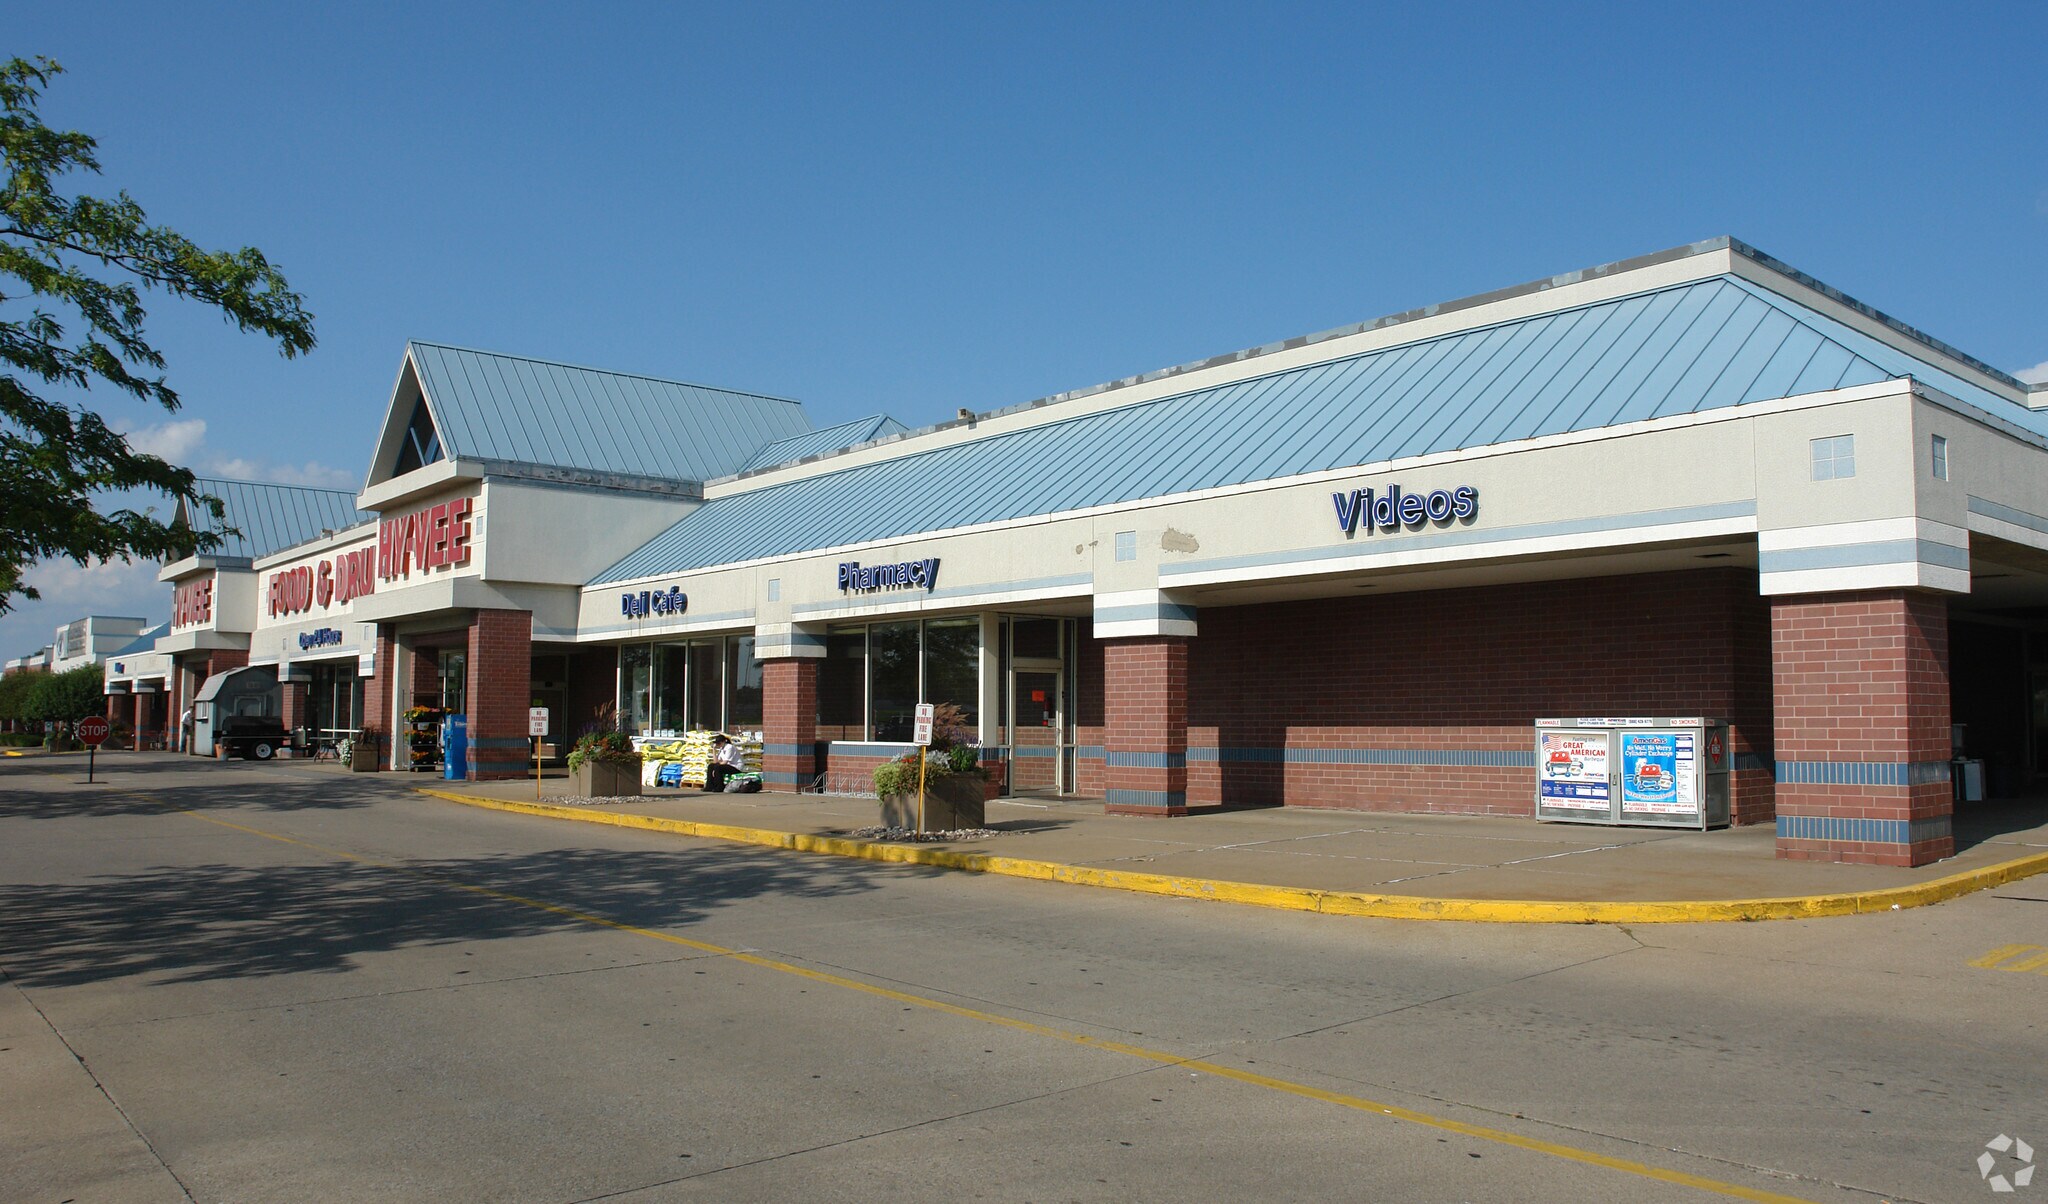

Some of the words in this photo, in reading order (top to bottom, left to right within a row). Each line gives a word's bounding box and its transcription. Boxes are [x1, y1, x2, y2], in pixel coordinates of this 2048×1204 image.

[1331, 483, 1477, 534] Videos
[378, 498, 472, 579] HY-VEE
[268, 565, 313, 617] FOOD
[316, 560, 333, 607] &
[838, 558, 939, 592] Pharmacy
[622, 591, 650, 617] Deli
[652, 586, 688, 614] Cafe
[80, 725, 108, 737] STOP
[1562, 741, 1584, 749] GREAT
[1570, 749, 1606, 757] AMERICAN
